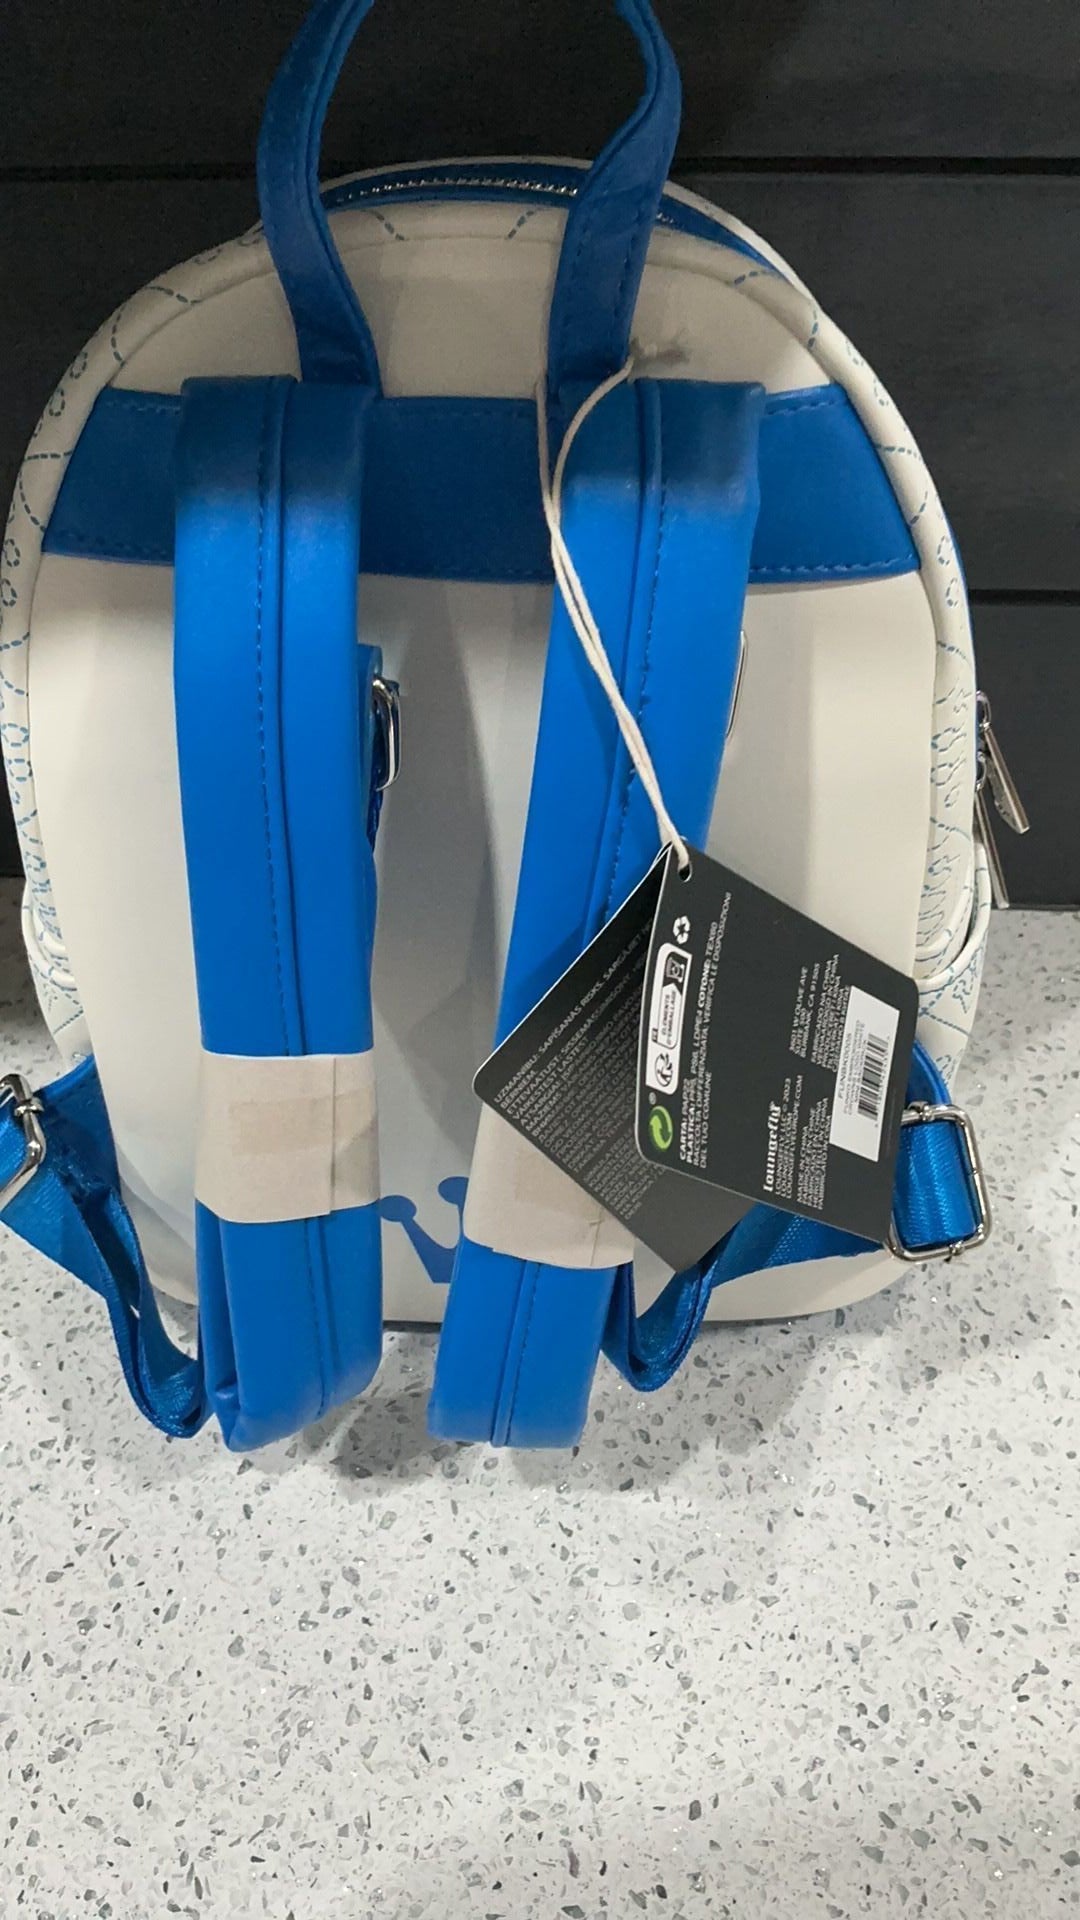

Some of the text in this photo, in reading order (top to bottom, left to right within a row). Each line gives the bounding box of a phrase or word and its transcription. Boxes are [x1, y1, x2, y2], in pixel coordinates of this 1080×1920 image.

[822, 959, 832, 990] CHINA
[829, 953, 839, 984] CHINA
[794, 986, 804, 1015] OLIVE
[799, 966, 808, 986] AVE
[693, 1110, 701, 1165] RACCOLTA
[702, 977, 715, 1022] VERIFICA
[712, 891, 731, 960] DISPOSIZIONI
[702, 1071, 712, 1119] COMUNE
[783, 1077, 791, 1101] 2023
[819, 1097, 828, 1128] CHINA
[799, 1125, 808, 1157] CHINA
[699, 1147, 707, 1168] DEL
[796, 1172, 804, 1201] MADE
